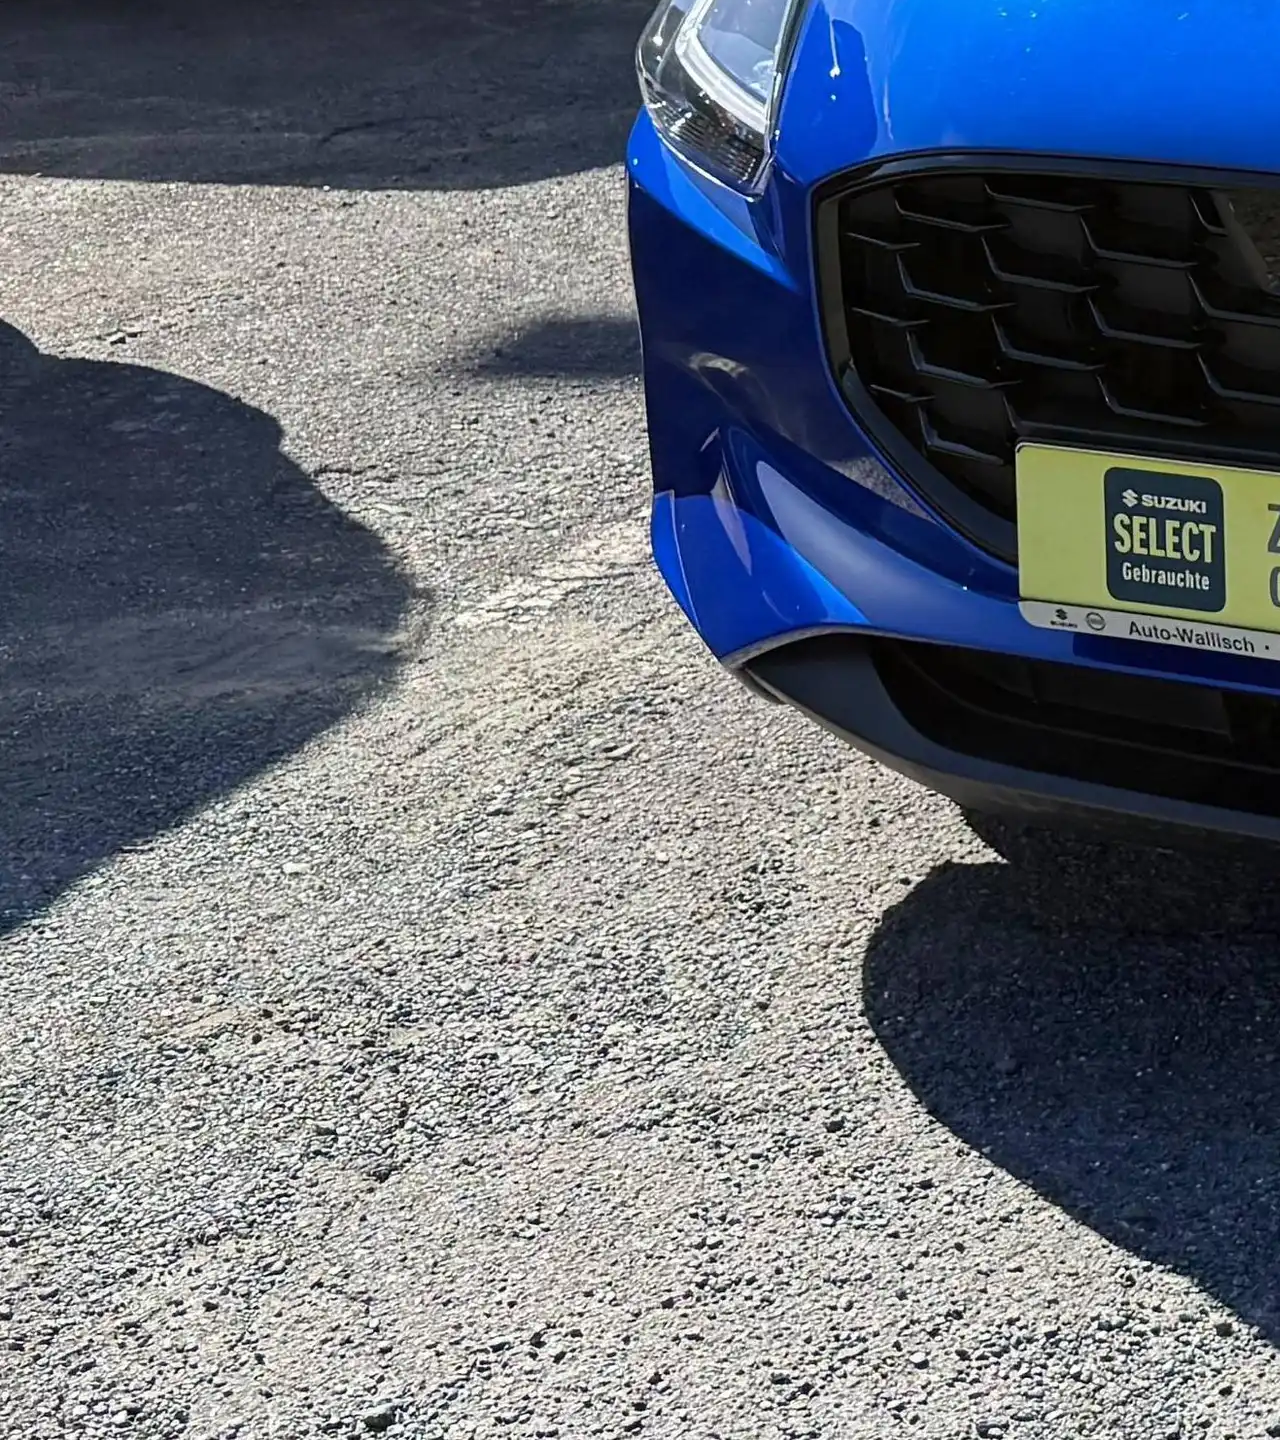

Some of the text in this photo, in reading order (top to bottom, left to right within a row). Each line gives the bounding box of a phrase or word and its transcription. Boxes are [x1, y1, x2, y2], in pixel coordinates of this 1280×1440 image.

[1141, 493, 1207, 514] SUZUKI
[1113, 513, 1217, 564] SELECT
[1122, 561, 1210, 591] Gebrauchte
[1129, 620, 1255, 653] Auto-Wallisch
